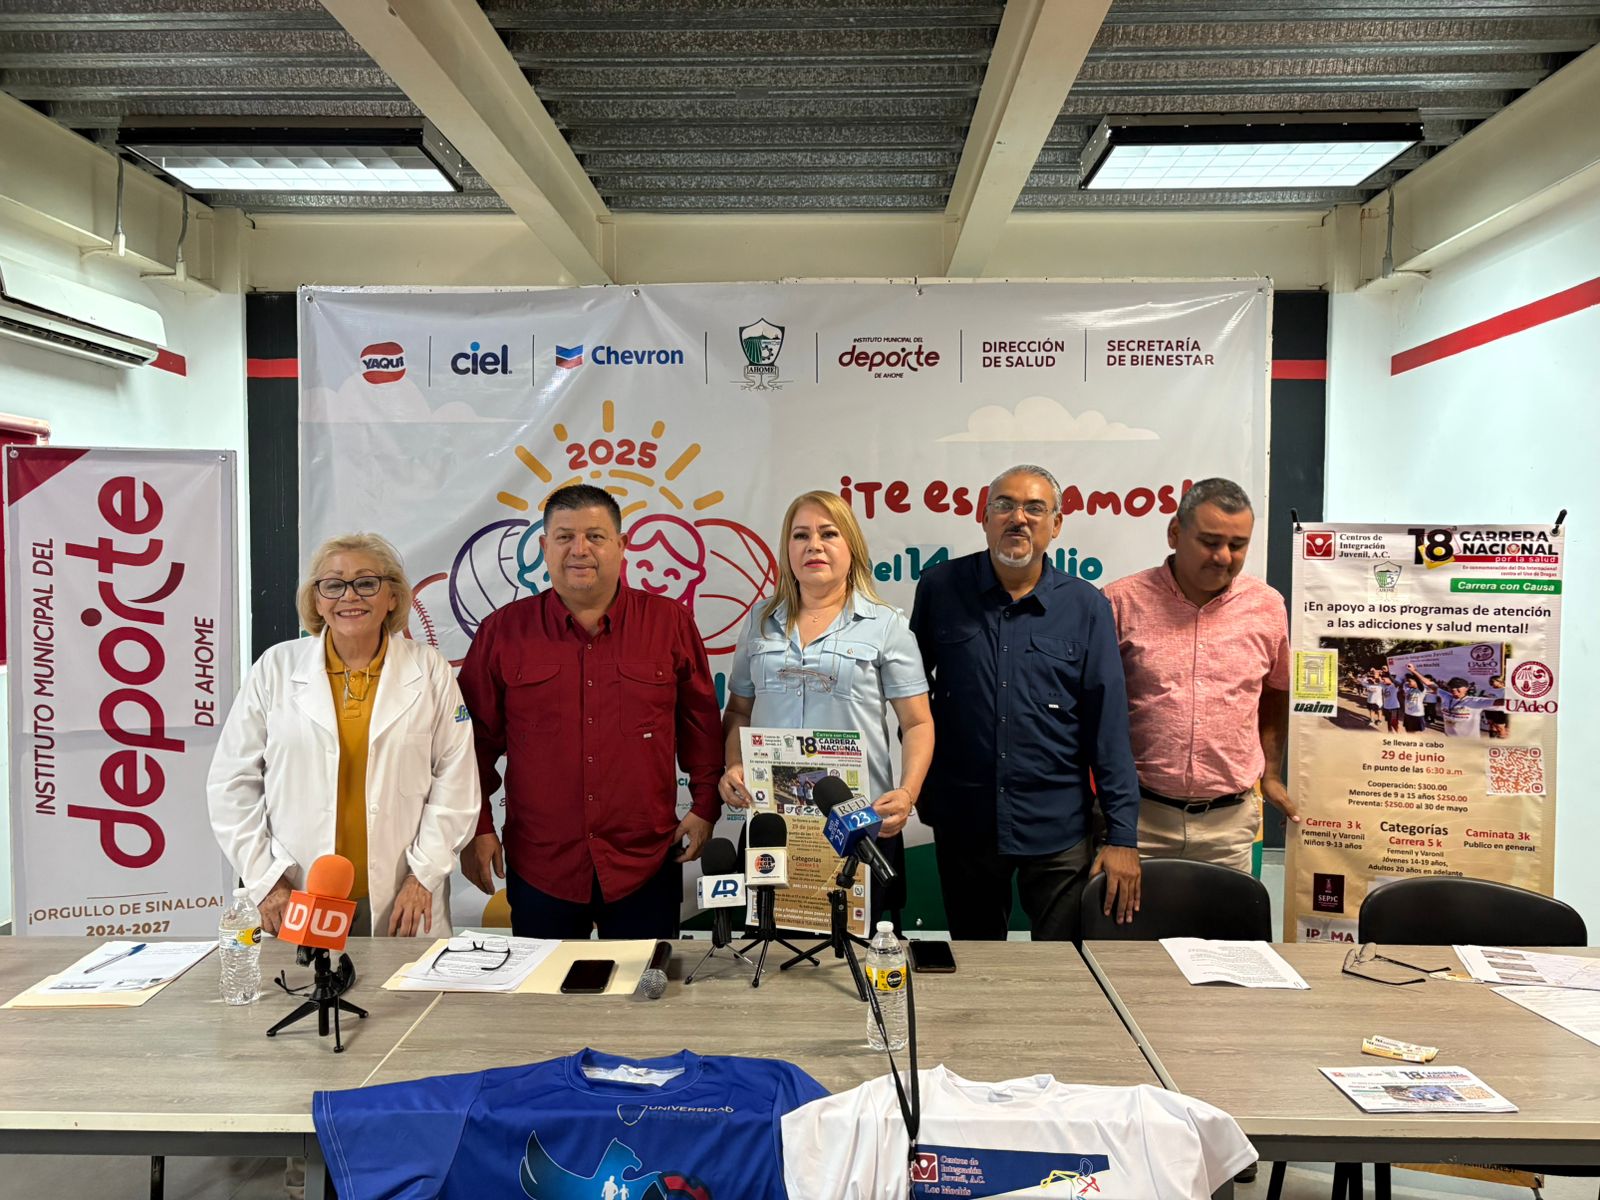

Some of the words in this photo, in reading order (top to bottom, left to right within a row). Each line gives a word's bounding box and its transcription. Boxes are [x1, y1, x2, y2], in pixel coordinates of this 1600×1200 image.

[982, 337, 1065, 353] DIRECCIÓN
[1107, 337, 1202, 352] SECRETARÍA
[451, 341, 509, 375] ciel
[591, 345, 684, 366] Chevron
[838, 344, 940, 372] deporte
[982, 355, 1002, 368] DE
[1005, 355, 1056, 368] SALUD
[1106, 354, 1126, 366] DE
[1130, 354, 1215, 367] BIENESTAR
[363, 356, 405, 370] YAQUI
[749, 366, 776, 374] AHOME
[566, 438, 658, 471] 2025
[1340, 533, 1371, 541] Centros
[1372, 533, 1383, 541] de
[1459, 530, 1549, 543] CARRERA
[1340, 542, 1386, 551] Integración
[1462, 543, 1559, 556] NACIONAL
[32, 538, 54, 577] DEL
[1339, 550, 1371, 559] Juvenil,
[1371, 551, 1391, 559] A.C.
[1515, 555, 1525, 563] la
[868, 554, 902, 582] el
[1458, 581, 1497, 591] Carrera
[1500, 583, 1520, 591] con
[1522, 582, 1555, 592] Causa
[1304, 601, 1323, 612] ¡En
[1327, 603, 1365, 614] apoyo
[1368, 604, 1376, 612] a
[1379, 604, 1397, 613] los
[1400, 605, 1469, 617] programas
[1472, 605, 1490, 616] de
[1493, 606, 1551, 617] atención
[1327, 619, 1334, 628] a
[1338, 618, 1355, 628] las
[1358, 618, 1422, 630] adicciones
[1425, 623, 1433, 633] y
[1436, 621, 1472, 632] salud
[1476, 623, 1529, 634] mental!
[33, 583, 55, 698] MUNICIPAL
[194, 616, 214, 695] AHOME
[65, 475, 185, 869] deporte
[194, 698, 214, 727] DE
[1294, 701, 1334, 714] uaim
[1505, 699, 1558, 714] UAdeO
[796, 736, 818, 755] 18
[818, 738, 856, 746] CARRERA
[1393, 739, 1418, 748] llevara
[1425, 741, 1444, 749] cabo
[34, 704, 56, 815] INSTITUTO
[1381, 750, 1396, 760] 29
[1398, 751, 1413, 761] de
[1415, 752, 1446, 764] junio
[1362, 763, 1373, 771] En
[1374, 764, 1399, 773] punto
[1400, 765, 1411, 773] de
[1412, 766, 1424, 774] las
[1425, 767, 1445, 775] 6:30
[1367, 780, 1416, 790] Cooperación:
[1417, 783, 1448, 792] $300.00
[1349, 789, 1381, 798] Menores
[1383, 790, 1392, 798] de
[1417, 793, 1435, 801] años
[1437, 794, 1468, 803] $250.00
[838, 799, 867, 815] RED
[1348, 799, 1383, 808] Preventa:
[1384, 800, 1415, 809] $250.00
[851, 811, 871, 827] 23
[1306, 818, 1342, 829] Carrera
[1347, 820, 1353, 829] 3
[1355, 820, 1362, 830] k
[1301, 829, 1331, 838] Femenil
[1338, 832, 1365, 841] Varonil
[1380, 821, 1449, 837] Categorías
[1465, 828, 1515, 840] Caminata
[1517, 831, 1531, 841] 3k
[1304, 839, 1325, 848] Niños
[1326, 840, 1343, 848] 9-13
[1344, 842, 1363, 850] años
[1389, 836, 1425, 847] Carrera
[1427, 838, 1434, 847] 5
[1436, 838, 1443, 848] k
[1463, 840, 1492, 849] Publico
[1505, 844, 1536, 852] general
[1387, 848, 1414, 856] Femenil
[1421, 850, 1445, 858] Varonil
[1382, 857, 1409, 865] Jóvenes
[1411, 858, 1430, 866] 14-19
[1368, 864, 1394, 872] Adultos
[1433, 868, 1464, 878] adelante
[28, 904, 115, 925] ¡ORGULLO
[120, 902, 141, 916] DE
[145, 895, 225, 913] SINALOA!
[86, 920, 171, 937] 2024-2027
[648, 1105, 734, 1113] UNIVERSIDAD
[940, 1155, 969, 1166] Centros
[970, 1157, 979, 1166] de
[941, 1165, 983, 1176] Integración
[924, 1184, 940, 1194] Los
[941, 1186, 972, 1196] Mochis
